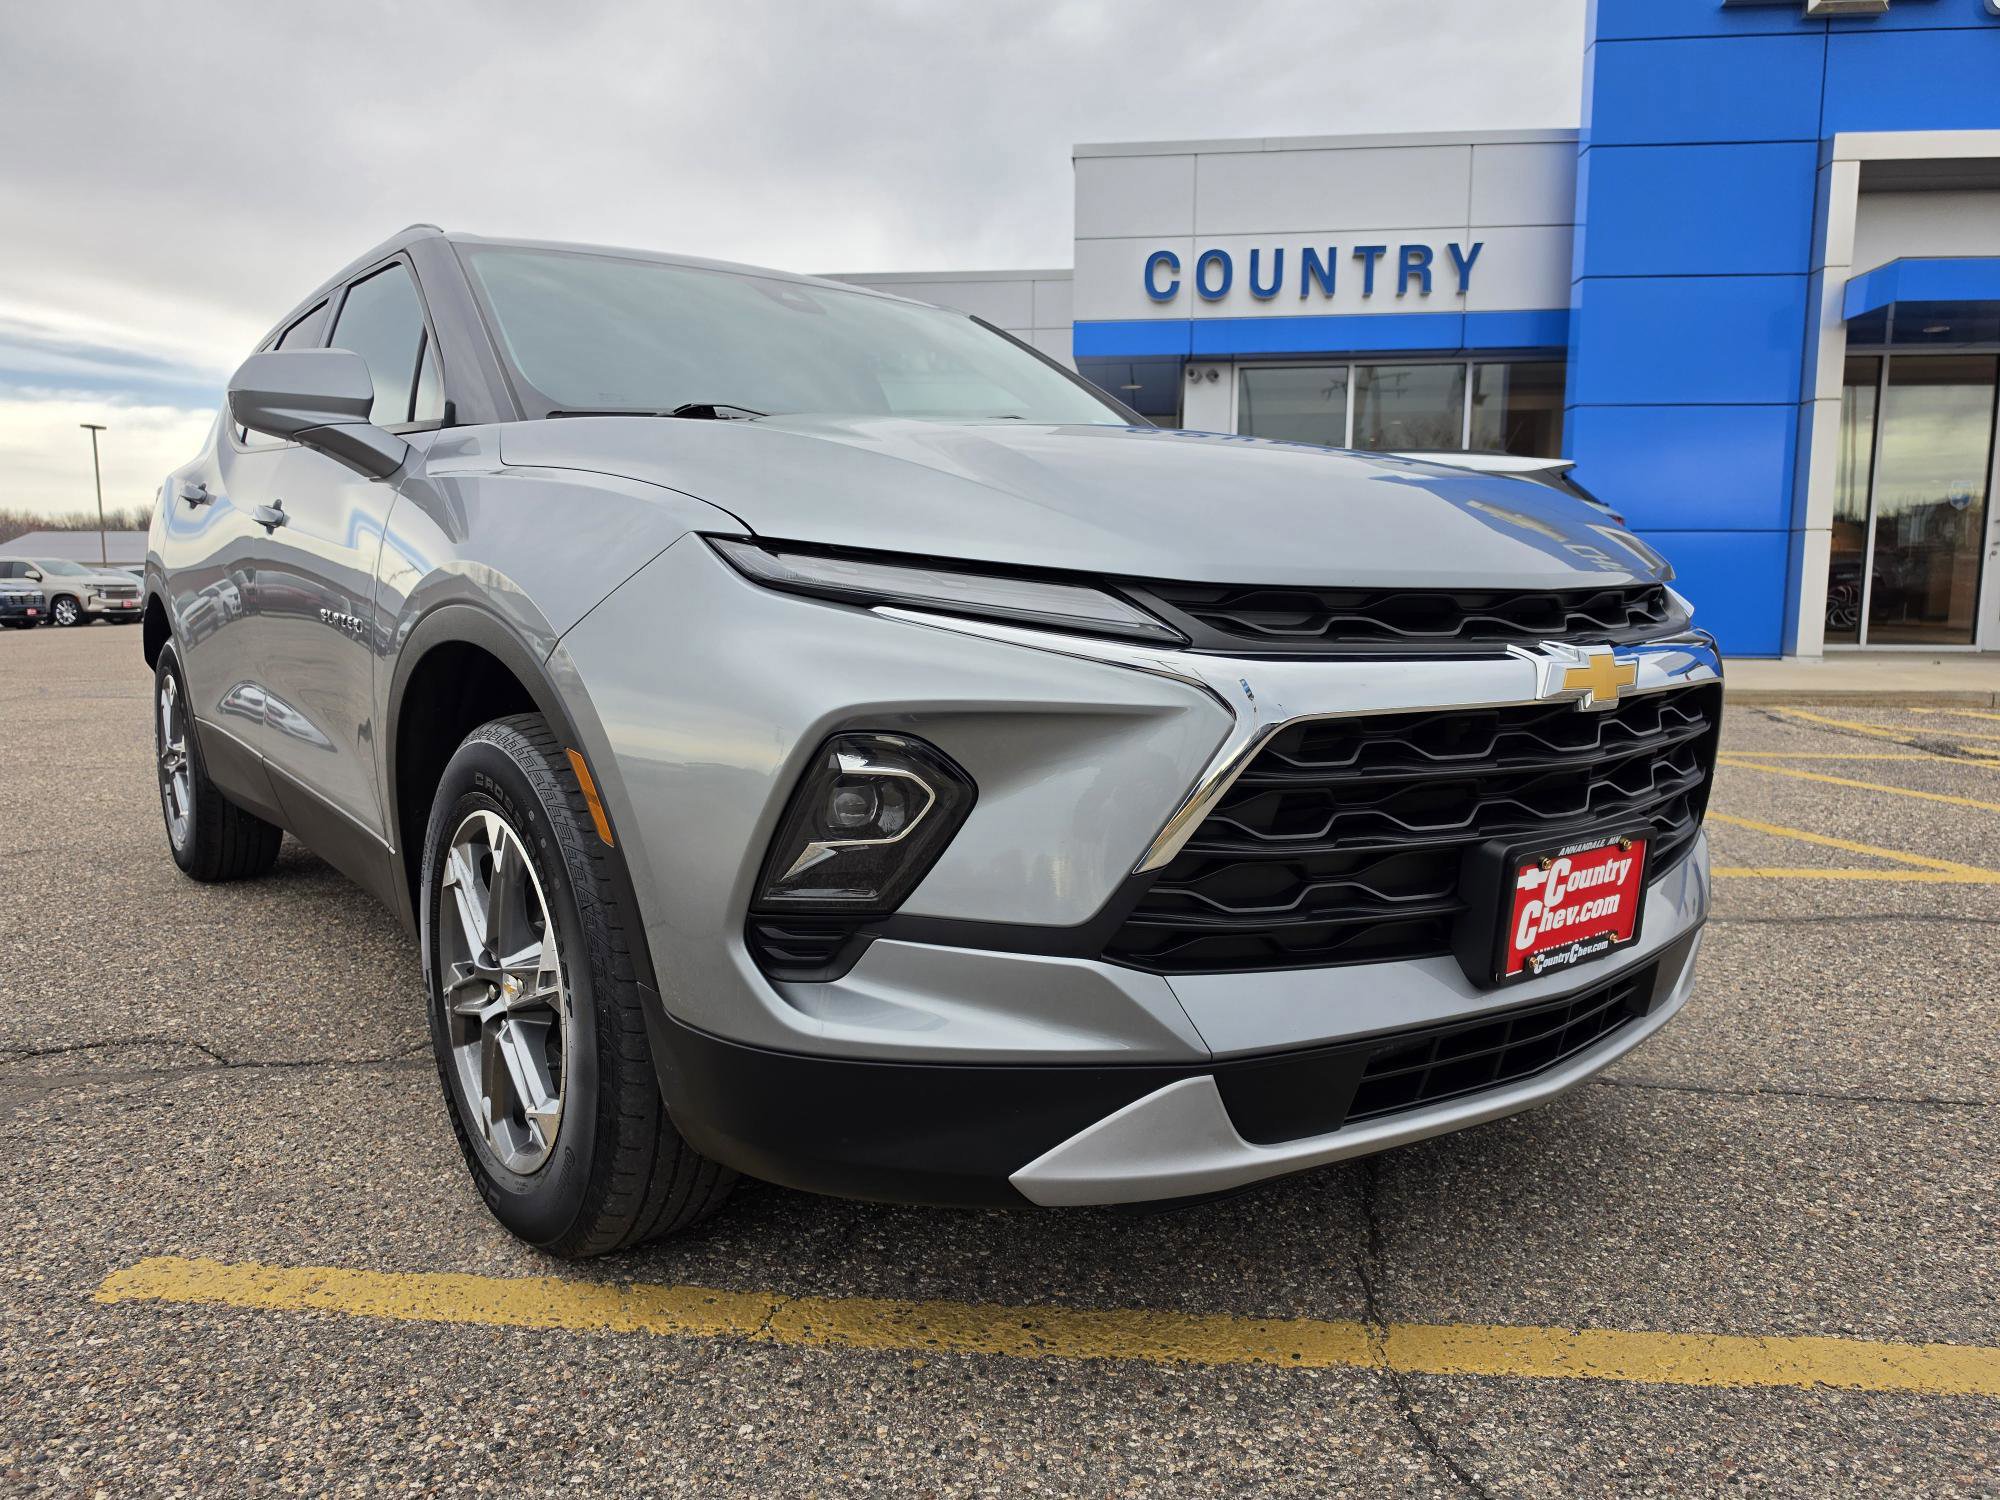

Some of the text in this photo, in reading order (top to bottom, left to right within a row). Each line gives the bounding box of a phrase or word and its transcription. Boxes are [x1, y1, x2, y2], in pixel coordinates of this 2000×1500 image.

[1144, 242, 1484, 302] COUNTRY
[1558, 839, 1606, 856] ANNANDALE
[1544, 858, 1632, 908] Country
[1515, 894, 1621, 950] Chev.com
[1533, 941, 1609, 975] CountryChev.com
